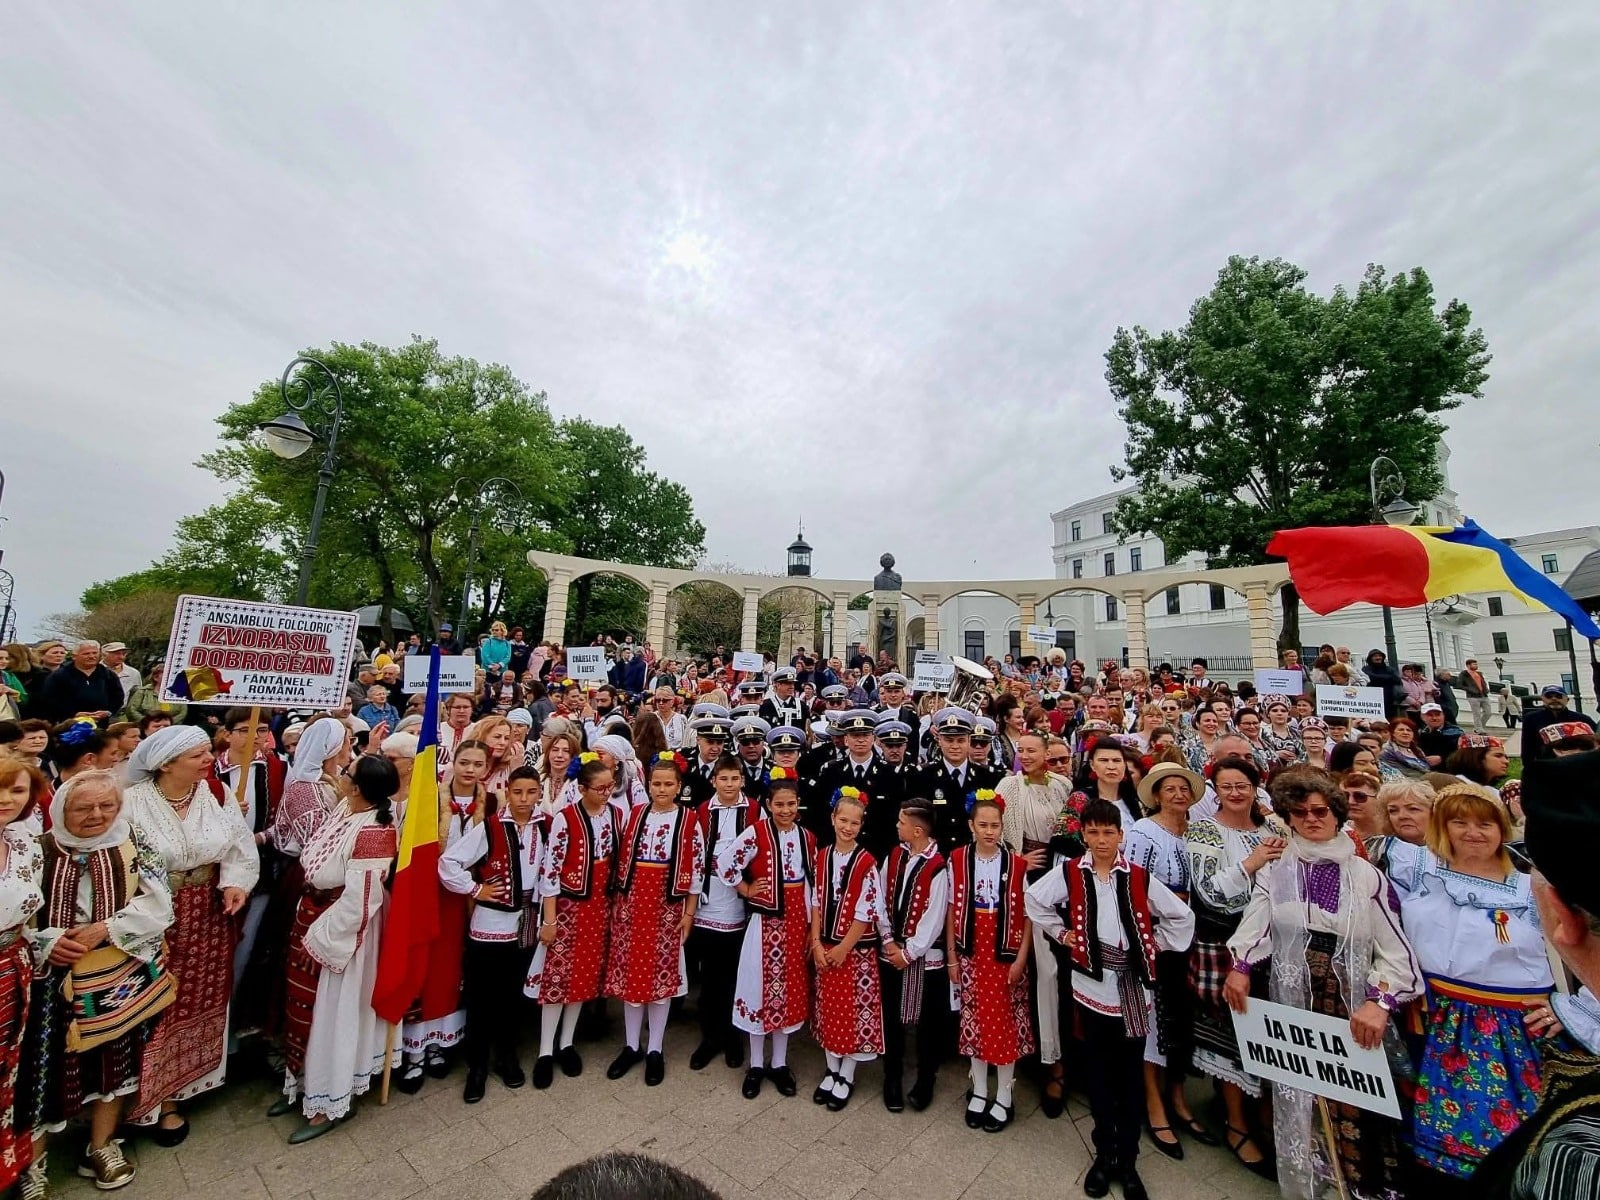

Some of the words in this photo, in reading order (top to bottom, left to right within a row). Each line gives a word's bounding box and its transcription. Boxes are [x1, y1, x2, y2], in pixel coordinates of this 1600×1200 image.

[207, 611, 275, 629] ANSAMBLUL
[278, 618, 333, 634] FOLCLORIC
[190, 647, 334, 676] DOBROGEAN
[248, 684, 305, 696] ROMÂNIA
[1289, 1023, 1317, 1050] DE
[1319, 1031, 1349, 1058] LA
[1246, 1040, 1314, 1079] MALUL
[1315, 1060, 1386, 1099] MĂRII
